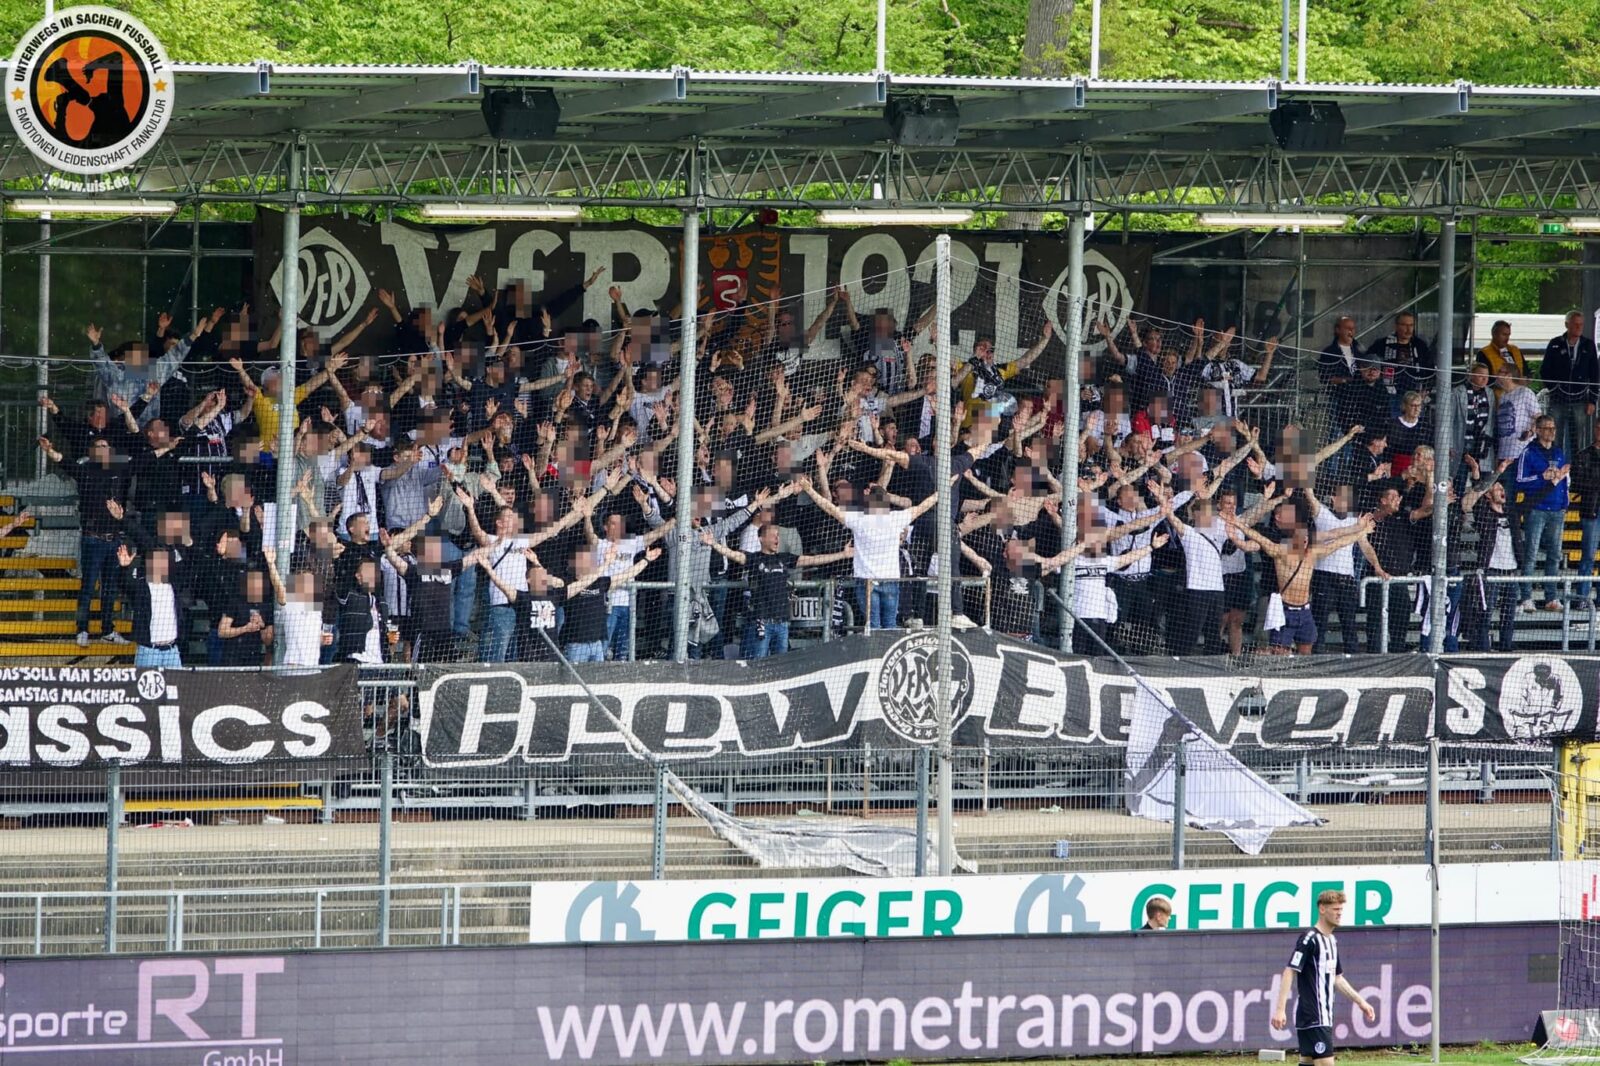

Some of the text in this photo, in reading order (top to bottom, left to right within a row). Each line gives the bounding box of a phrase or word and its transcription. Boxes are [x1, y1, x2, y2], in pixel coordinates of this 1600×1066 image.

[789, 233, 1030, 360] 1921
[0, 668, 20, 681] AS
[59, 668, 90, 682] MAN
[93, 667, 137, 682] SONST
[419, 671, 870, 768] Crew
[687, 889, 964, 940] GEIGER
[137, 957, 284, 1041] RT
[537, 963, 1432, 1060] www.rometransport.de
